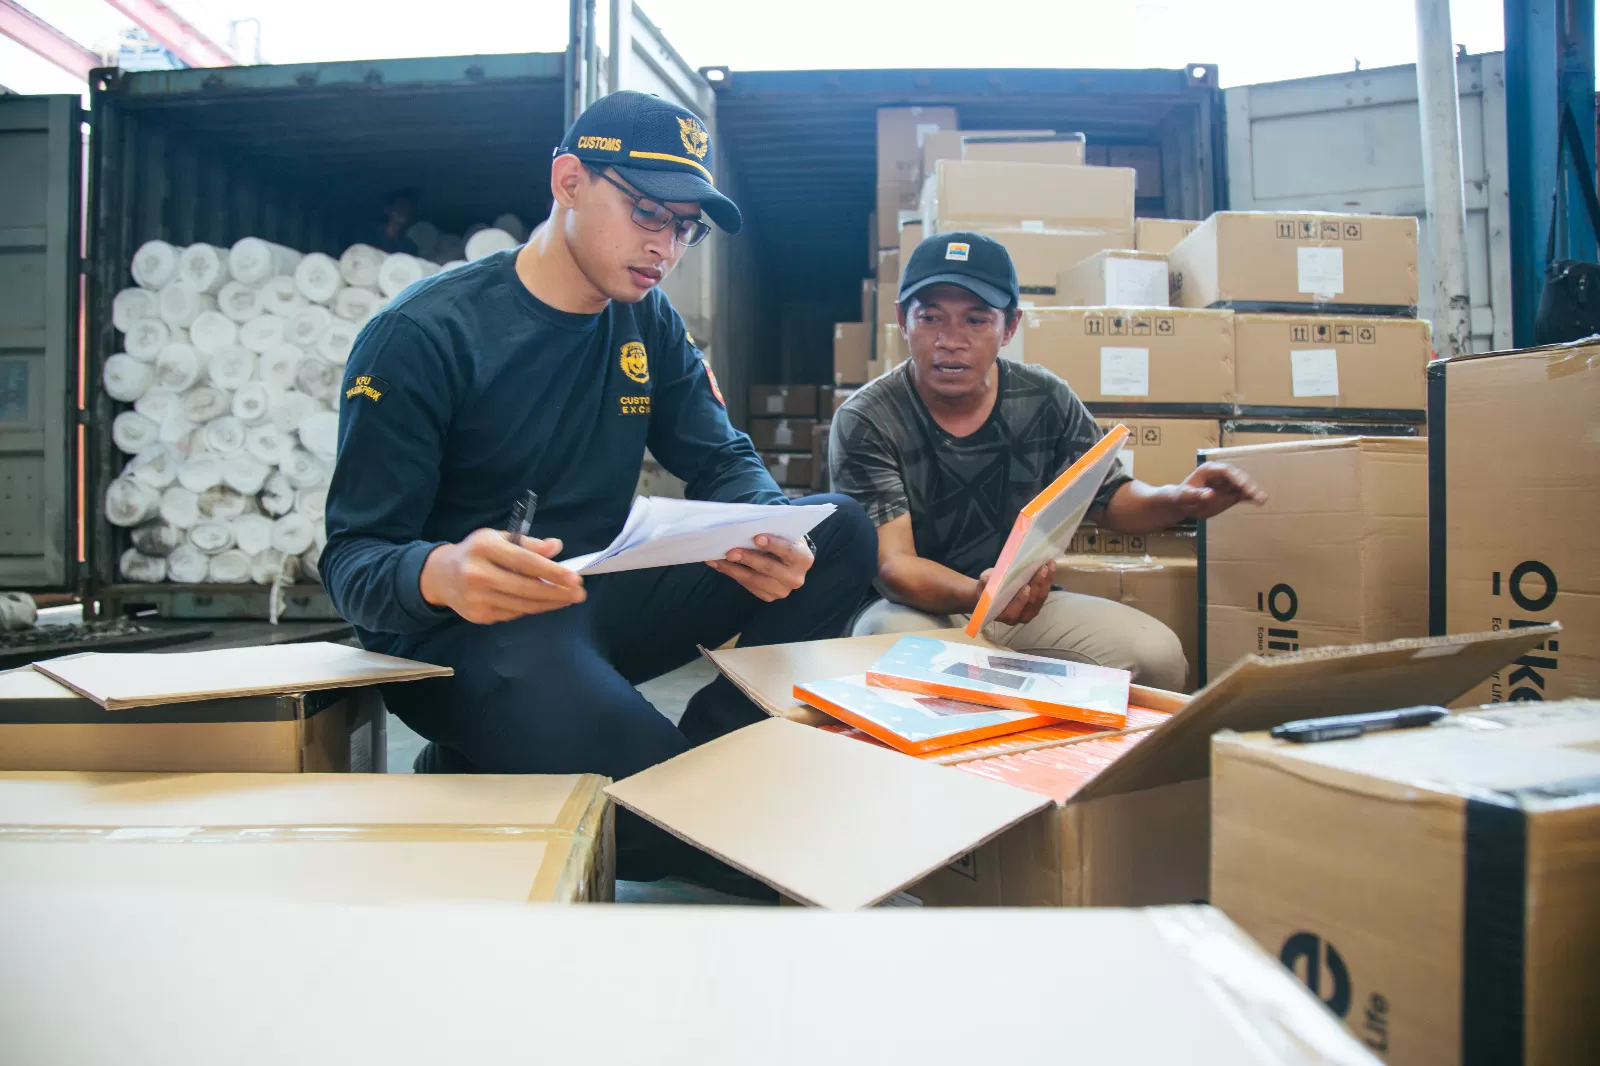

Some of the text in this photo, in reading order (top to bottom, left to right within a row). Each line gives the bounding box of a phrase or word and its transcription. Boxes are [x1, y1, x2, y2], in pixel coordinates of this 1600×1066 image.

[578, 136, 622, 152] CUSTOMS
[356, 376, 371, 386] KPU
[620, 396, 651, 405] CUSTO
